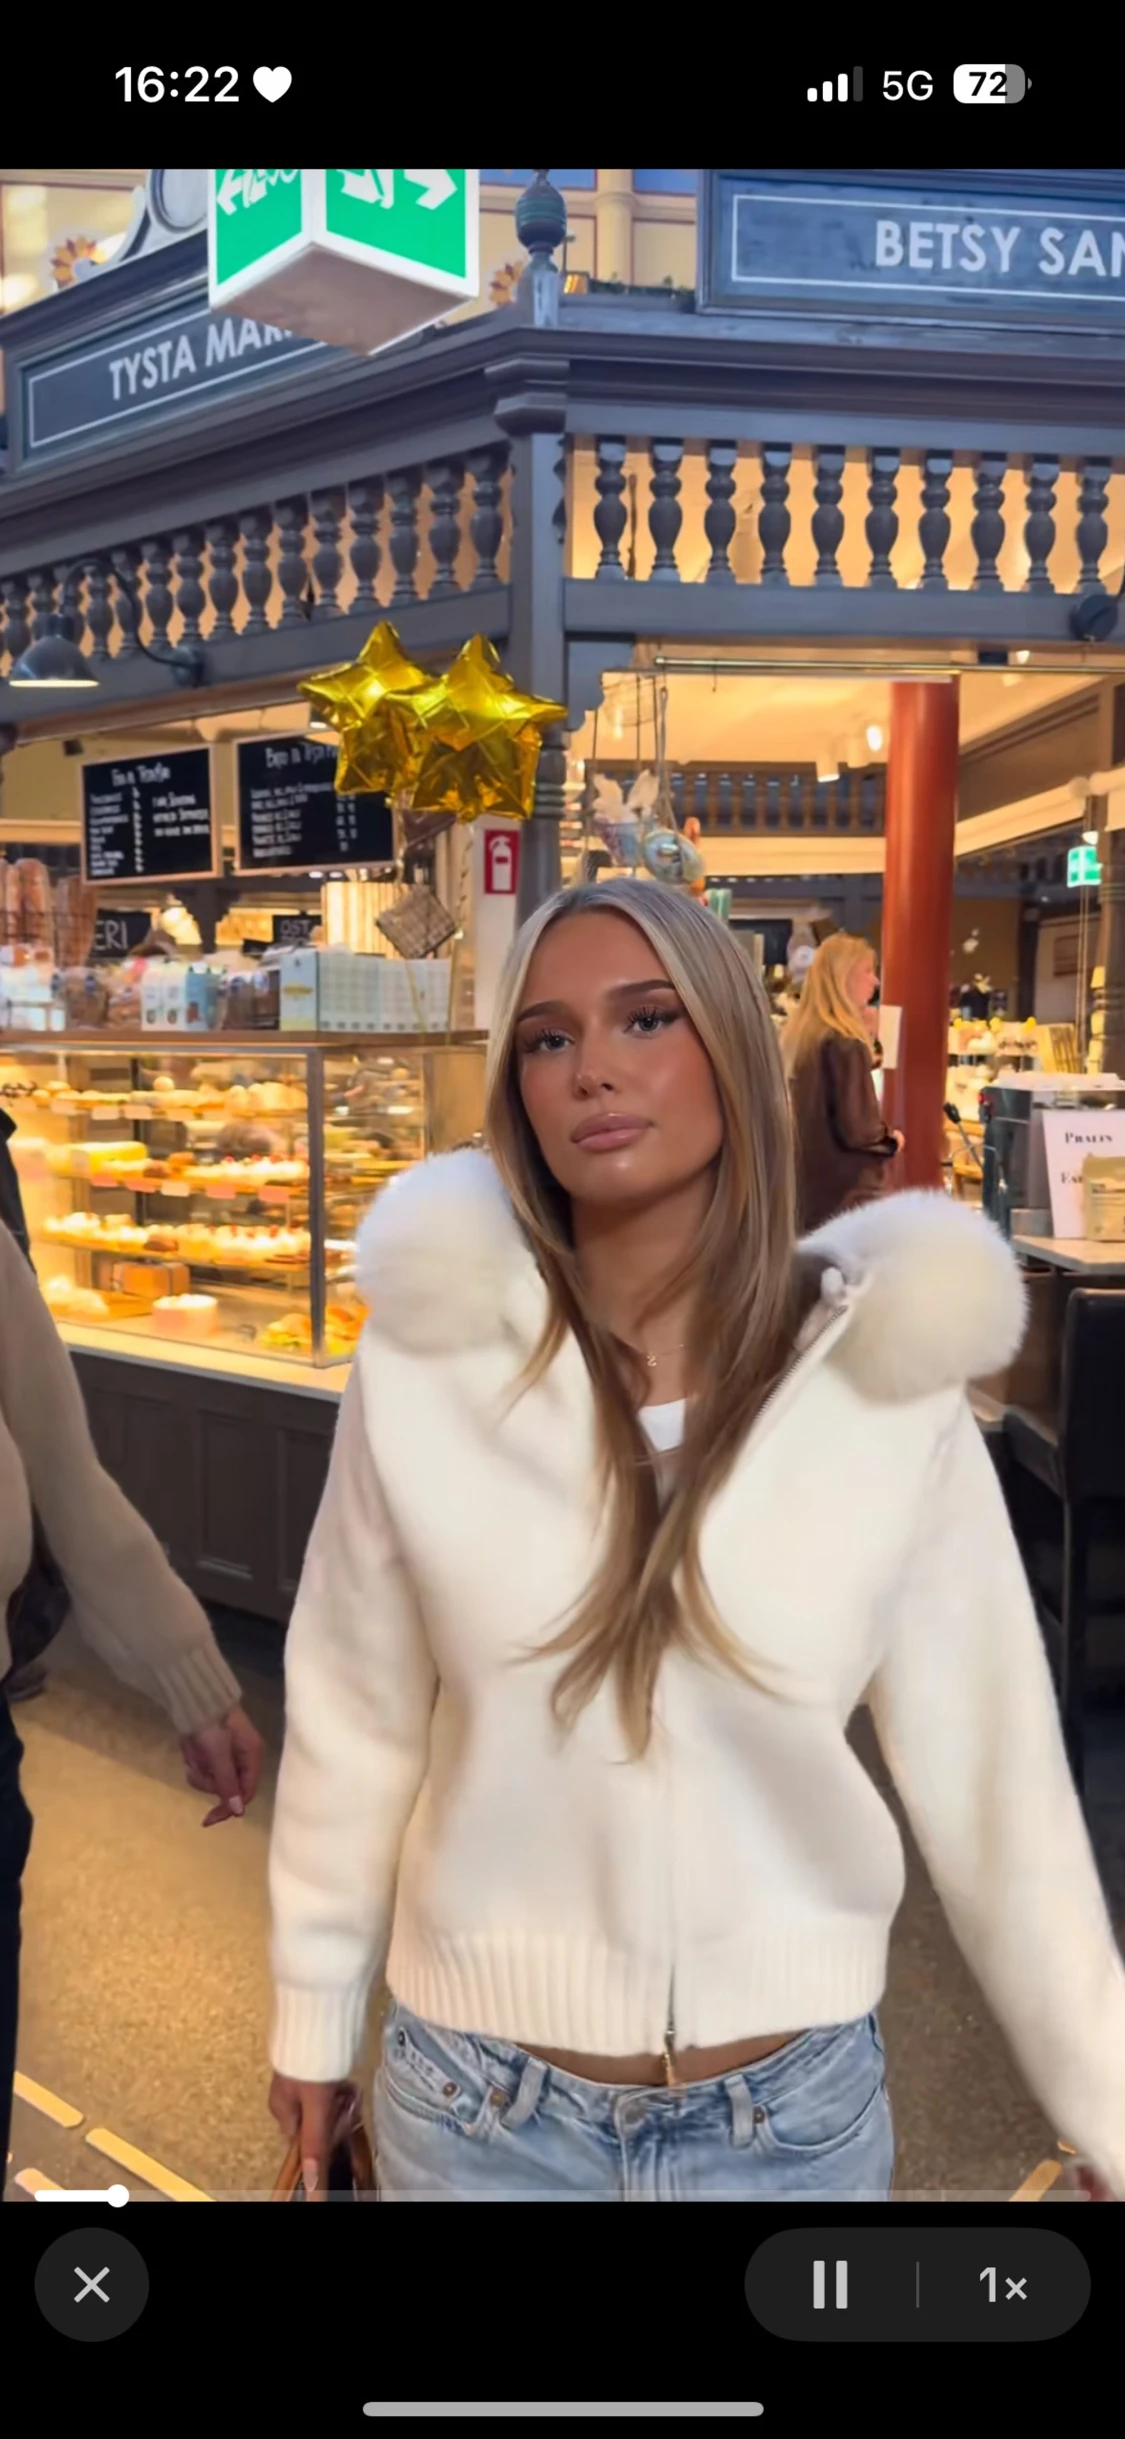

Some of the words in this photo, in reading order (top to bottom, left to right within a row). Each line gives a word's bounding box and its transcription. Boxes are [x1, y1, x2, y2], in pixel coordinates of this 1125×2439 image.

[876, 220, 1021, 273] BETSY
[109, 334, 197, 401] TYSTA
[205, 317, 293, 367] MAR
